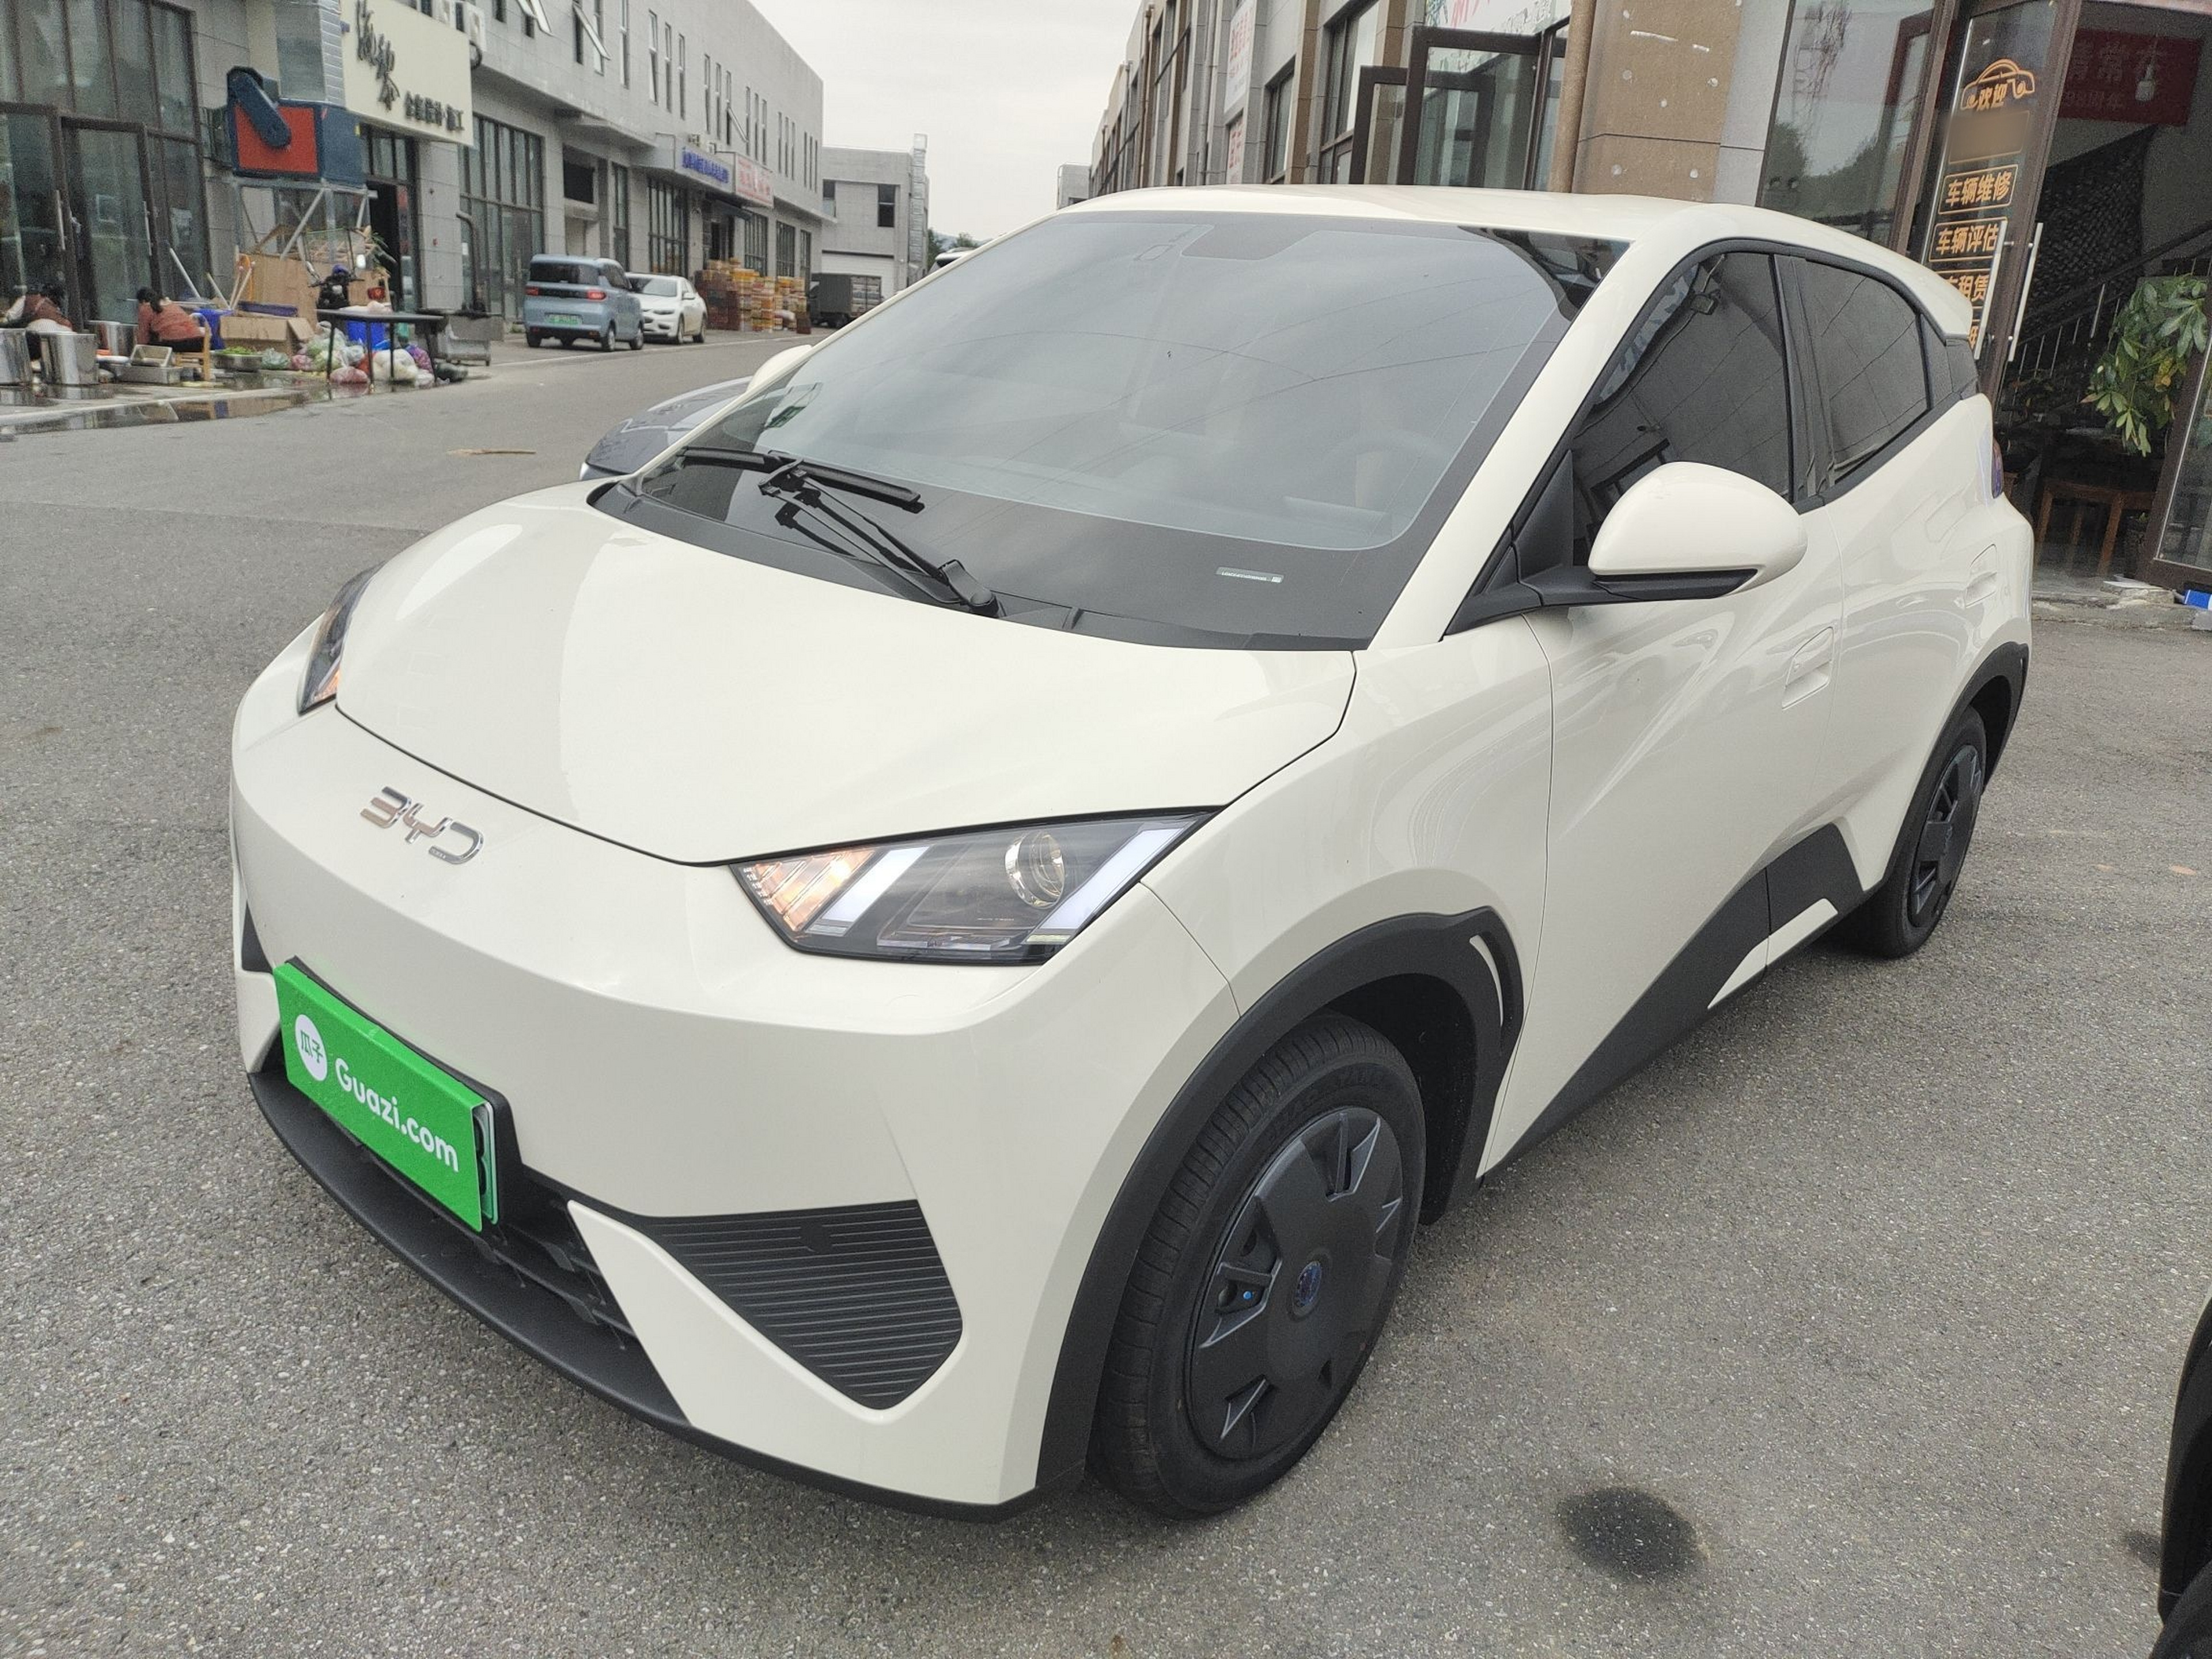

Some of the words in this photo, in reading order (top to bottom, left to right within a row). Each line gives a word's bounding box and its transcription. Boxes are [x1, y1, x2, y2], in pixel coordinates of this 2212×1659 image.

[1976, 83, 2008, 111] 欢迎
[1945, 171, 2012, 207] 车辆维修
[1936, 224, 1999, 255] 车辆评估
[359, 786, 484, 865] BYD
[300, 1029, 323, 1063] 瓜子
[335, 1058, 459, 1173] Guazi.com
